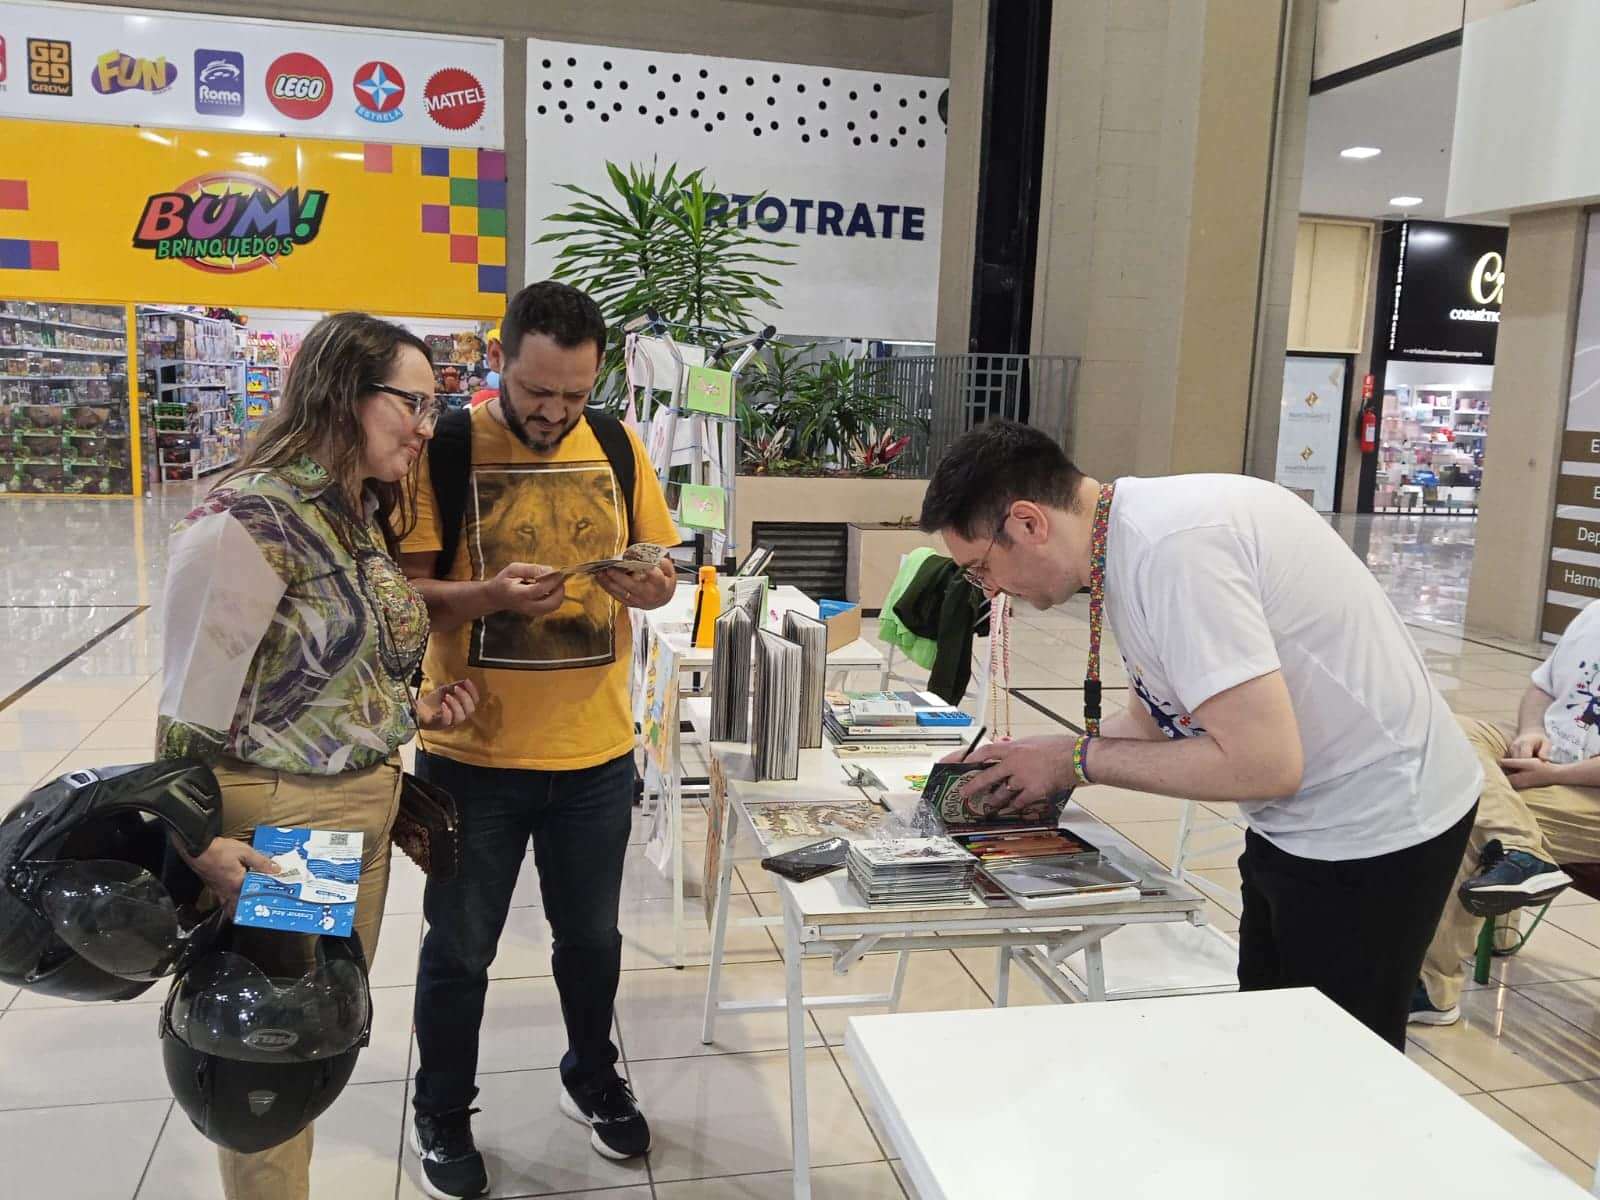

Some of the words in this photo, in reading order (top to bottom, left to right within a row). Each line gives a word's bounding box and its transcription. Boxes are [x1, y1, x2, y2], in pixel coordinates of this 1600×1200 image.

[97, 51, 166, 91] FUN
[31, 84, 70, 94] GROW
[200, 85, 241, 102] Roma
[275, 77, 323, 99] LEGO
[426, 88, 486, 112] MATTEL
[358, 107, 403, 121] ESTRELA
[133, 187, 327, 246] BUM!
[156, 236, 294, 259] BRINQUEDOS
